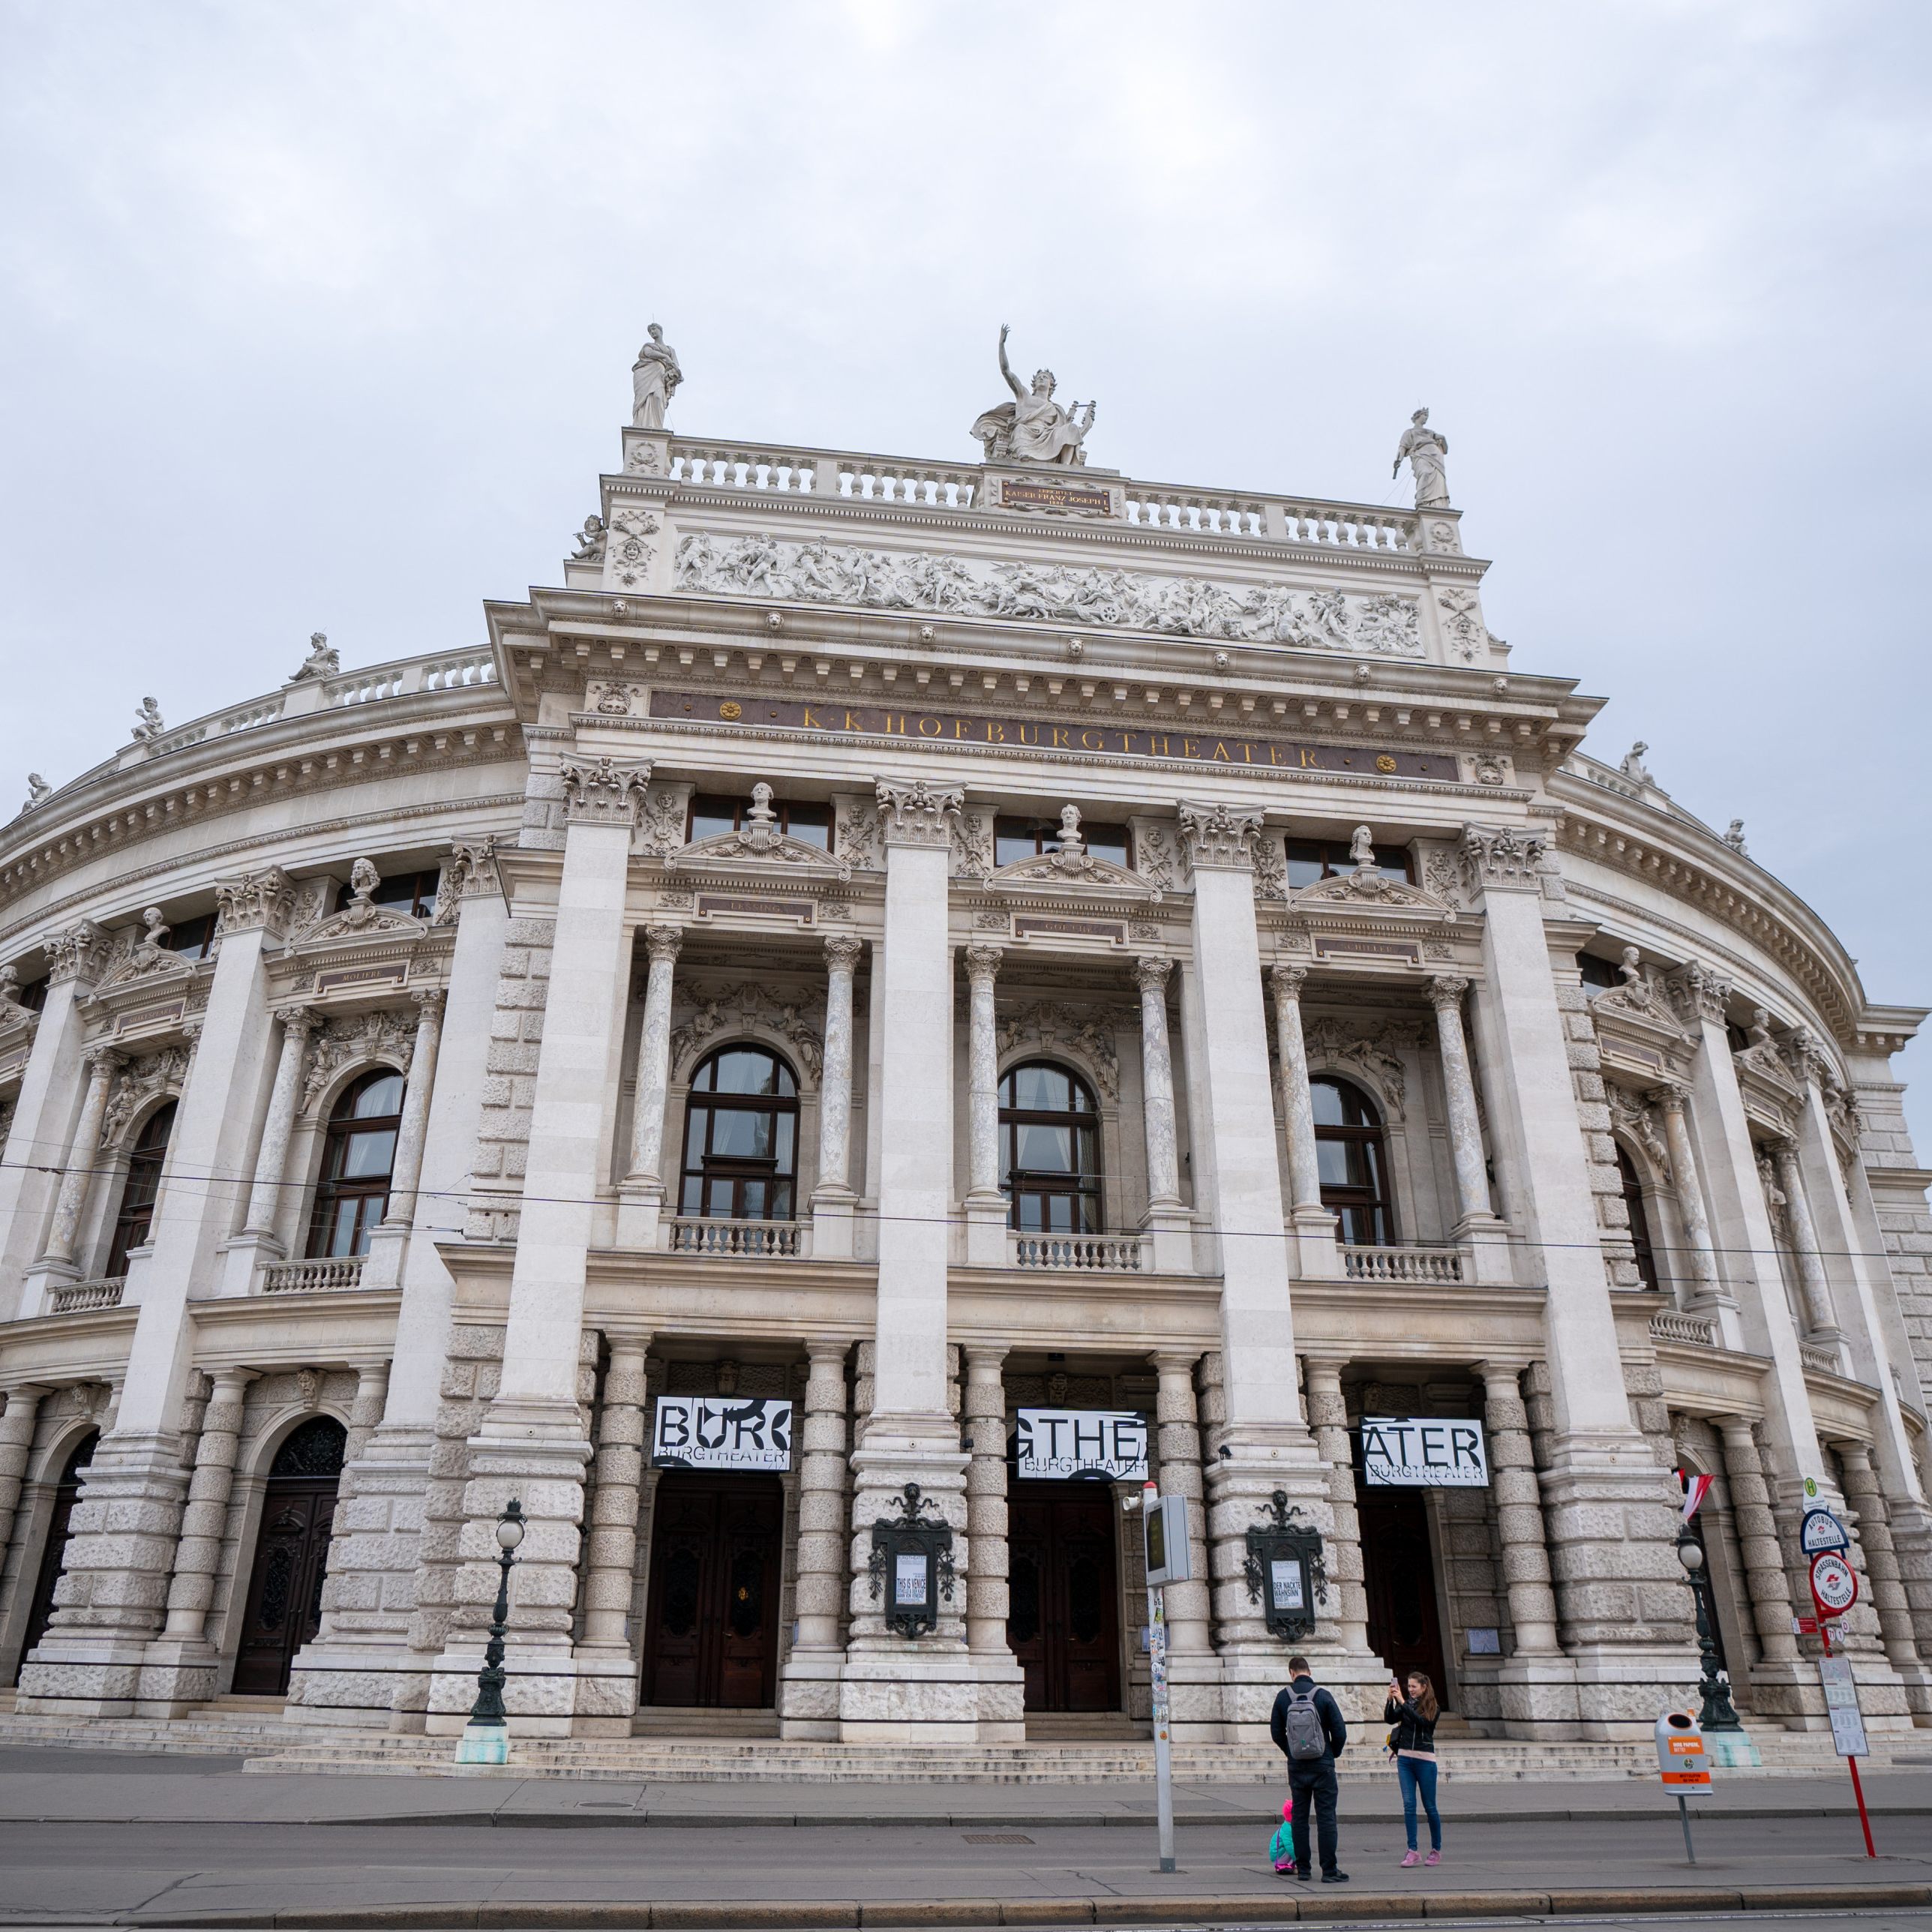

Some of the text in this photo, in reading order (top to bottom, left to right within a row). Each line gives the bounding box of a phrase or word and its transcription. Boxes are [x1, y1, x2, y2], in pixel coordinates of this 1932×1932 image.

[1006, 490, 1036, 499] KAISER
[1068, 496, 1101, 505] JOSEPH
[658, 1446, 785, 1462] BURGTHEATER
[1024, 1457, 1144, 1472] BURGTHEATER
[1371, 1465, 1484, 1479] BURGTHEATER
[1809, 1516, 1833, 1531] AUTOBUS
[1808, 1534, 1841, 1547] HALTESTELLE
[1815, 1559, 1849, 1580] STRASSENBAHN
[897, 1578, 926, 1588] THIS IS VENICE
[1821, 1587, 1852, 1605] HALTESTELLE
